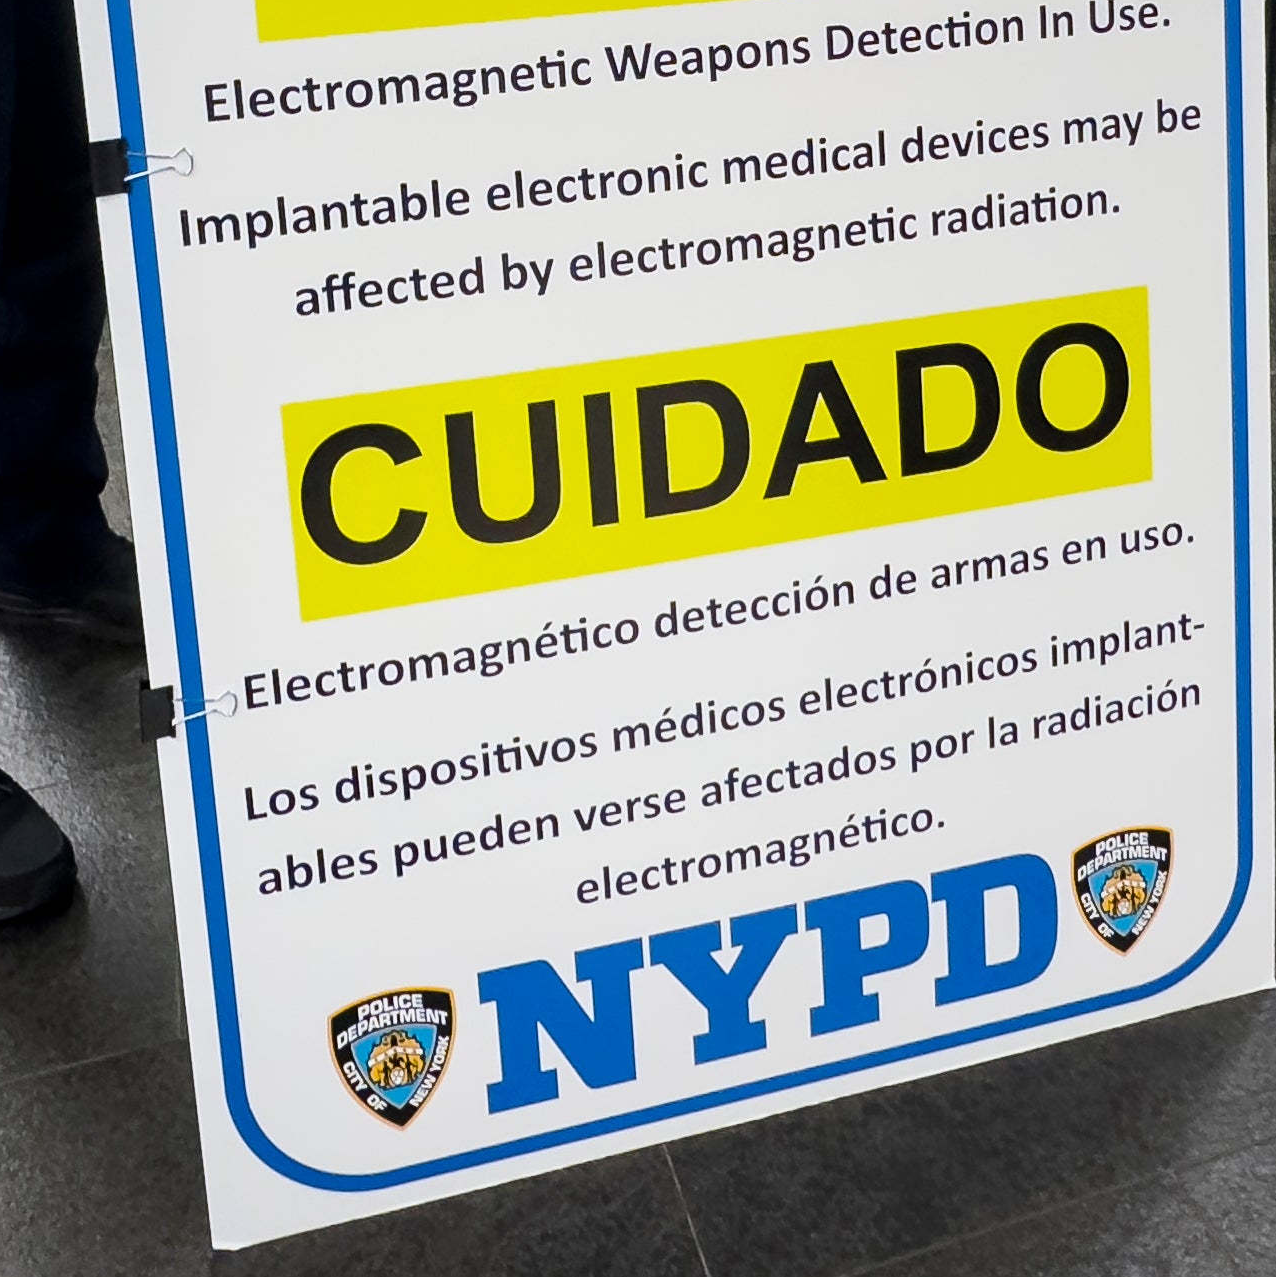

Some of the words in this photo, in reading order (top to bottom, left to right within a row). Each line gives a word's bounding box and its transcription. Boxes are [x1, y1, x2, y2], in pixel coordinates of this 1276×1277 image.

[204, 49, 592, 122] Electromagnetic
[604, 36, 811, 82] Weapons
[826, 10, 1024, 61] Detection
[1039, 4, 1074, 39] In
[179, 179, 470, 250] Implantable
[486, 153, 709, 211] electronic
[723, 130, 886, 185] medical
[901, 119, 1050, 164] devices
[1063, 111, 1144, 146] may
[1156, 98, 1201, 134] be
[296, 255, 485, 316] affected
[501, 252, 554, 296] by
[569, 206, 918, 282] electromagnetic
[931, 186, 1120, 236] radiation.
[299, 322, 1131, 567] CUIDADO
[244, 617, 639, 710] Electromagnético
[654, 575, 855, 638] detección
[869, 563, 917, 600] de
[931, 546, 1049, 589] armas
[1062, 536, 1106, 565] en
[1120, 522, 1194, 555] uso.
[244, 784, 319, 821] Los
[335, 732, 598, 804] dispositivos
[613, 696, 786, 752] médicos
[799, 648, 1038, 715] electrónicos
[1050, 613, 1205, 667] implant-
[258, 848, 378, 895] ables
[394, 813, 559, 878] pueden
[573, 789, 686, 832] verse
[701, 745, 896, 809] afectados
[910, 729, 975, 773] por
[988, 716, 1018, 749] la
[1033, 679, 1200, 739] radiación
[573, 808, 945, 904] electromagnético.
[1078, 846, 1167, 882] DEPARTMENT
[1096, 832, 1149, 856] POLICE
[1080, 892, 1100, 920] CITY
[1098, 923, 1114, 938] OF
[1132, 906, 1154, 935] NEW
[1152, 870, 1167, 905] YORK
[336, 1009, 448, 1050] DEPARTMENT
[357, 994, 423, 1021] POLICE
[478, 855, 1057, 1113] NYPD
[343, 1061, 368, 1092] CITY
[367, 1093, 387, 1111] OF
[409, 1073, 436, 1107] NEW
[430, 1035, 450, 1072] YORK
